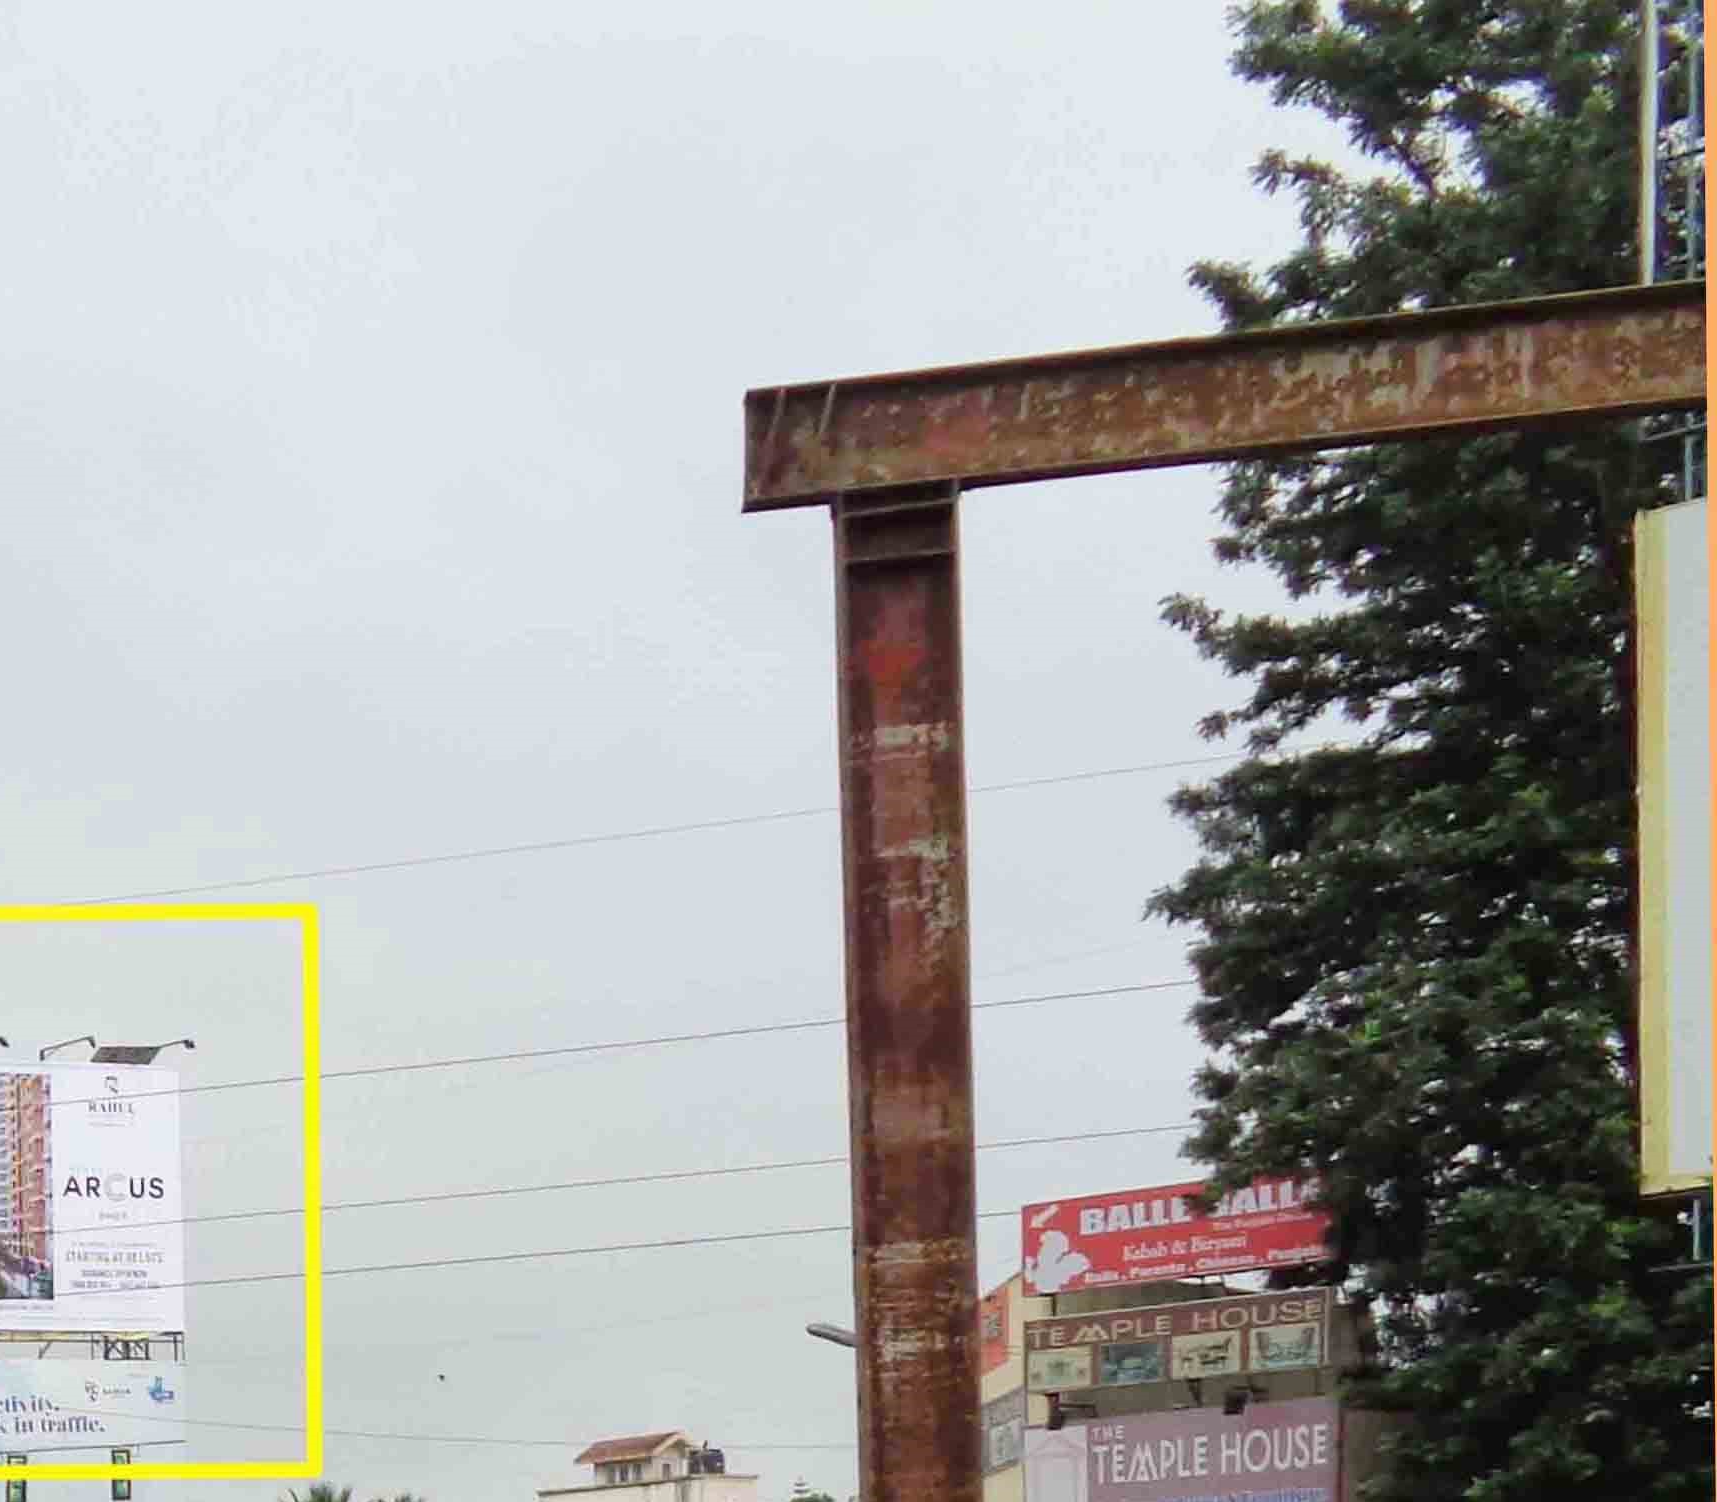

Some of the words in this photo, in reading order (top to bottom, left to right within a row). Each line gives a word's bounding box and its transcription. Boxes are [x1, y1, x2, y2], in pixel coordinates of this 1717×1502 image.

[62, 1172, 166, 1202] ARCUS
[1079, 1196, 1193, 1237] BALLE
[1026, 1313, 1173, 1349] TEMPLE
[1192, 1299, 1325, 1333] HOUSE
[13, 1417, 35, 1435] in
[39, 1416, 108, 1435] traffic.
[1090, 1424, 1126, 1441] THE
[1091, 1434, 1209, 1485] TEMPLE
[1220, 1424, 1328, 1474] HOUSE
